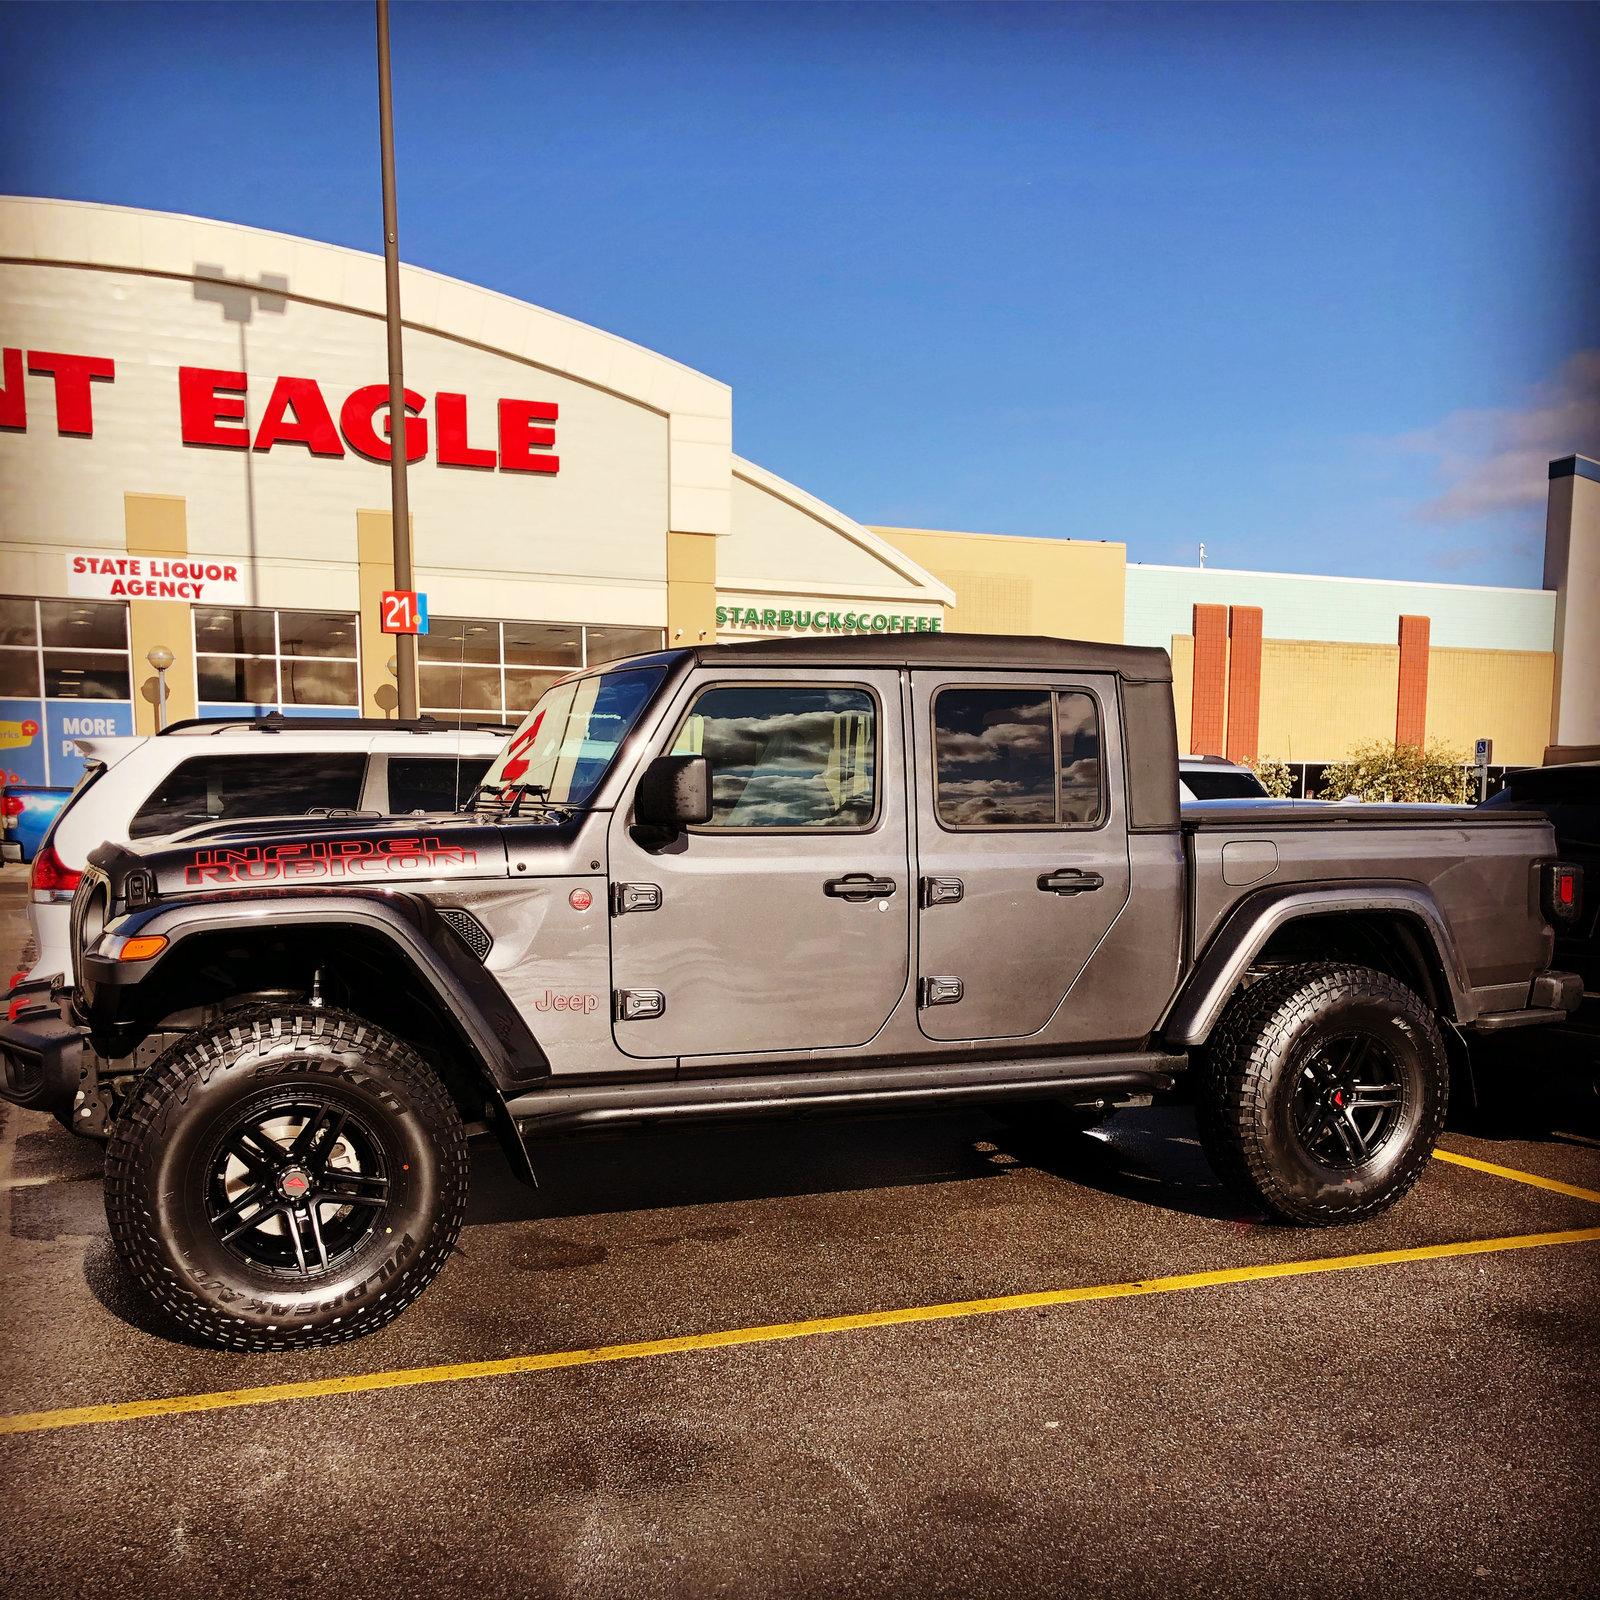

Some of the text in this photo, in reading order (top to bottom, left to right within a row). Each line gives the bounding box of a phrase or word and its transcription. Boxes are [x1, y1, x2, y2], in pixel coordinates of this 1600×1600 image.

[178, 365, 560, 474] EAGLE
[73, 556, 238, 582] STATE LIQUOR
[110, 578, 206, 600] AGENCY
[385, 595, 411, 628] 21
[62, 717, 116, 736] MORE
[196, 837, 467, 867] INFIDEL
[184, 850, 478, 885] RUBICON
[535, 989, 600, 1015] Jeep
